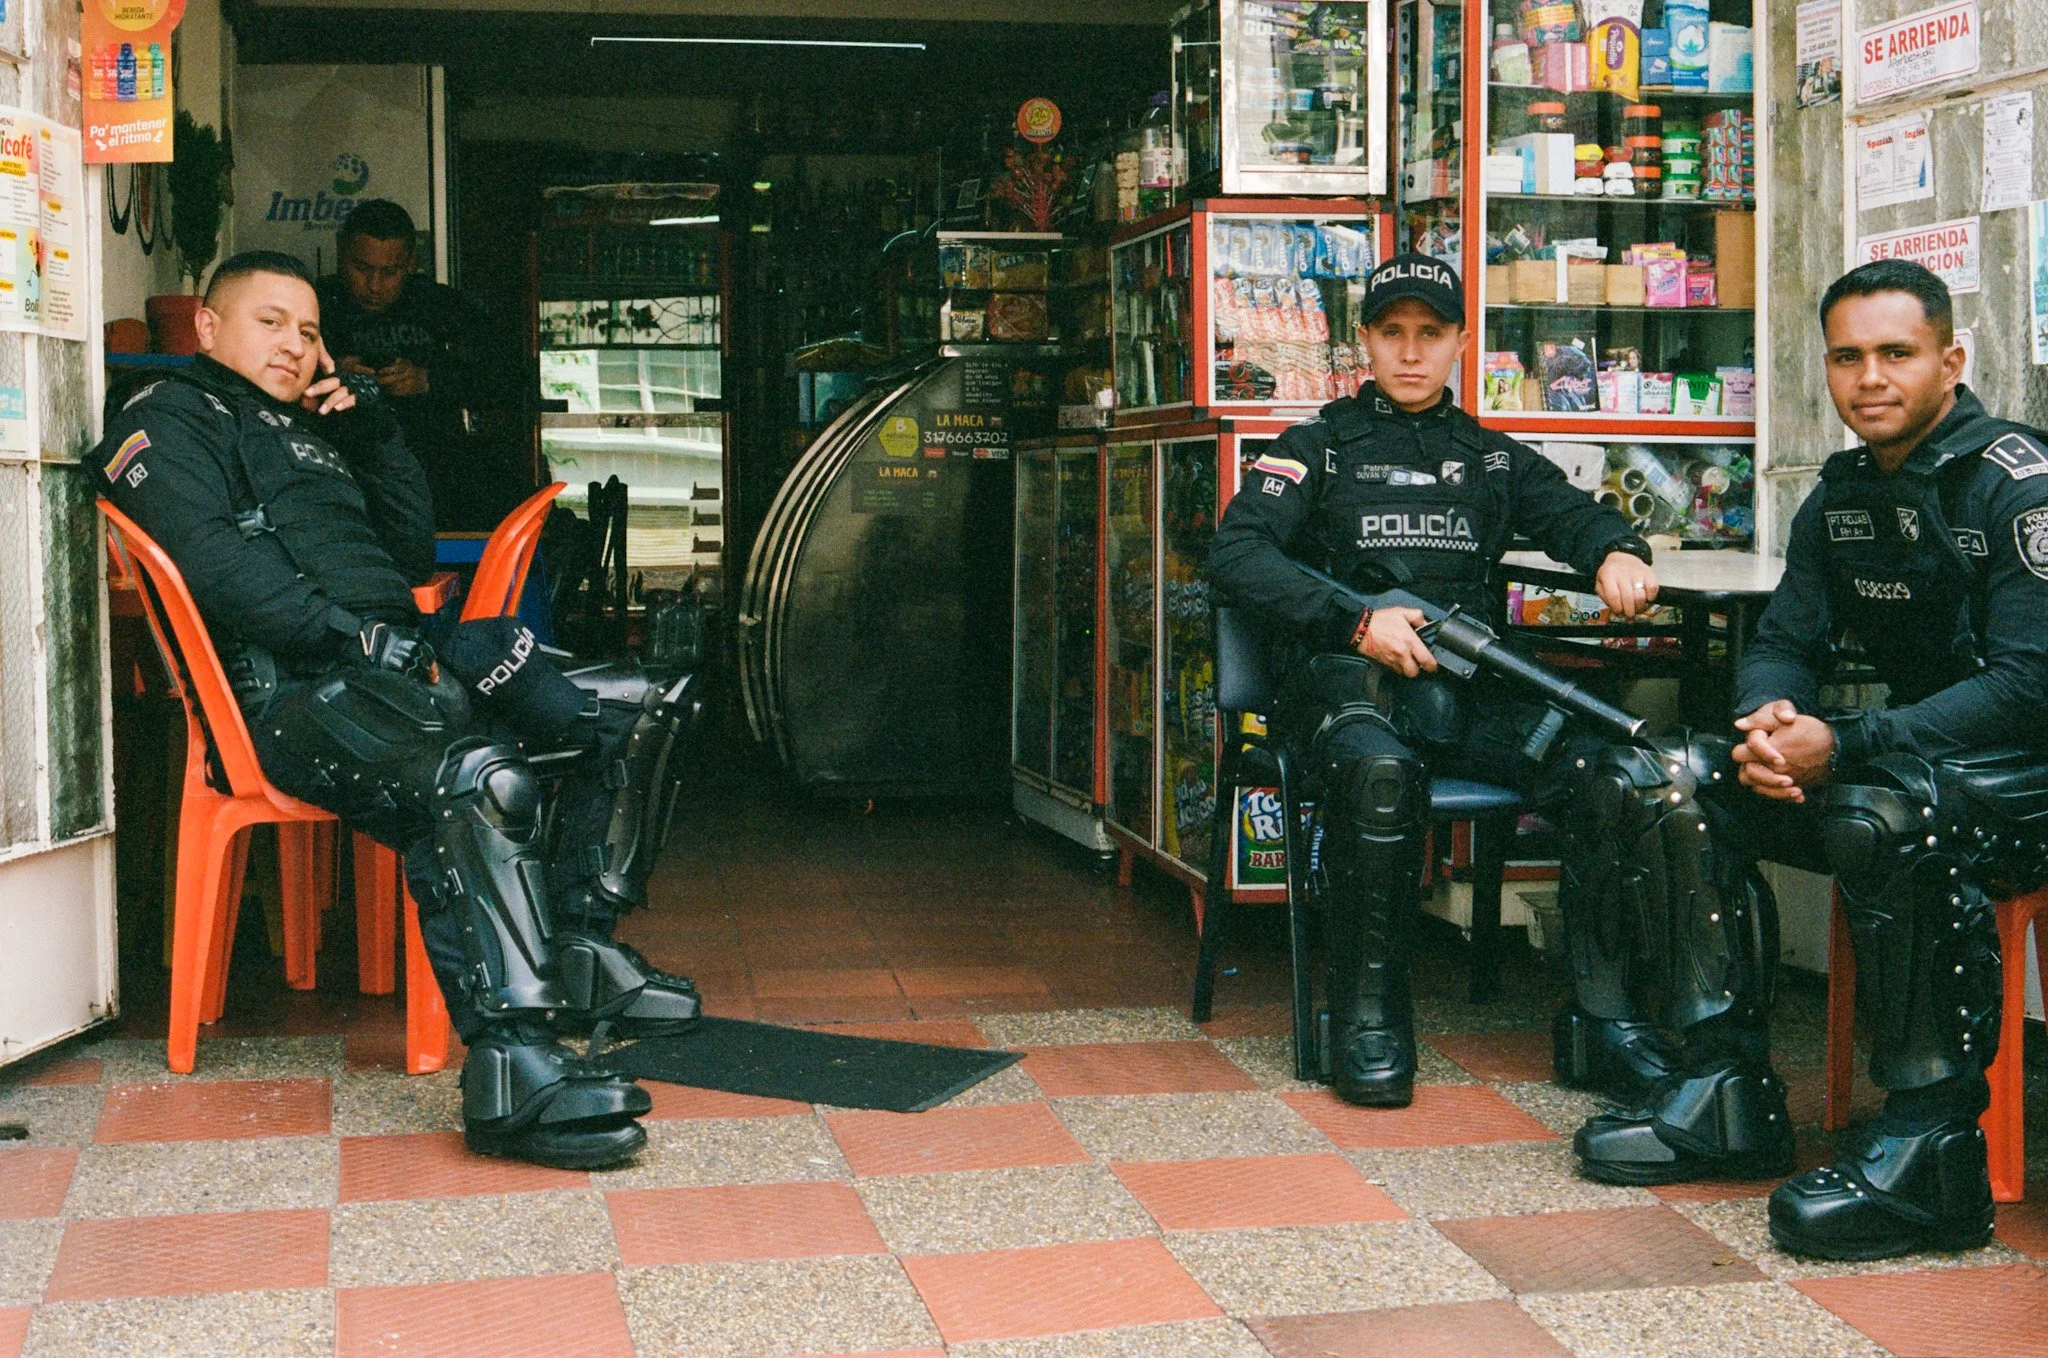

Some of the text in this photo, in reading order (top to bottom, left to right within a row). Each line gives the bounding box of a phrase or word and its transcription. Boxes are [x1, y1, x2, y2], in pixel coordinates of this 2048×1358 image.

[115, 12, 153, 20] HIDRATANTE
[1864, 37, 1884, 65] SE
[1888, 11, 1970, 55] ARRIENDA
[110, 118, 168, 136] mantener
[108, 131, 151, 147] el ritmo
[1869, 227, 1969, 261] SE ARRIENDA
[1370, 263, 1453, 292] POLICÍA
[936, 414, 984, 427] LA MACA
[923, 431, 1009, 444] 3176663707
[879, 466, 919, 477] LA MACA
[1266, 480, 1282, 492] A+
[1361, 508, 1474, 539] POLICÍA
[476, 627, 536, 696] POLICÍA
